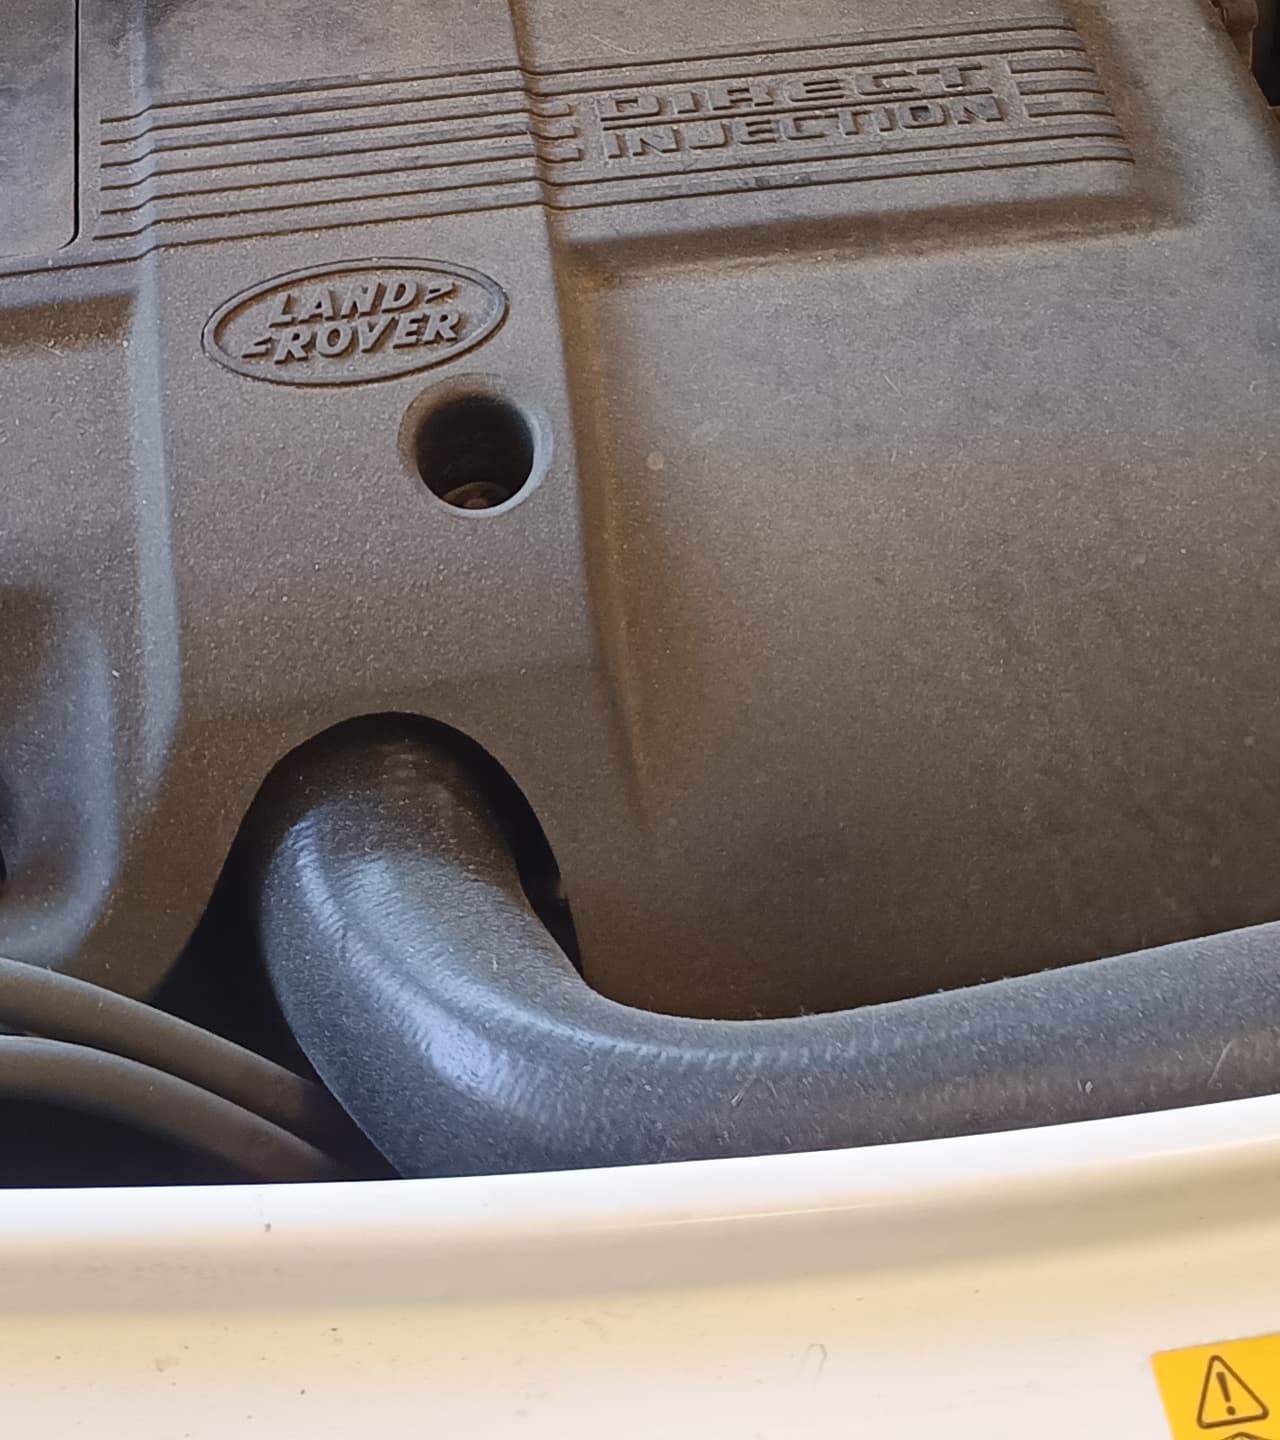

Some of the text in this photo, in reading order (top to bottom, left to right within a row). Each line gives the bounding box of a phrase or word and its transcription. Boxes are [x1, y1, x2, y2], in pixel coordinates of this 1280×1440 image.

[599, 62, 984, 122] DIRECT
[601, 94, 1008, 160] INJECTION
[268, 279, 420, 329] LAND
[273, 310, 463, 365] ROVER
